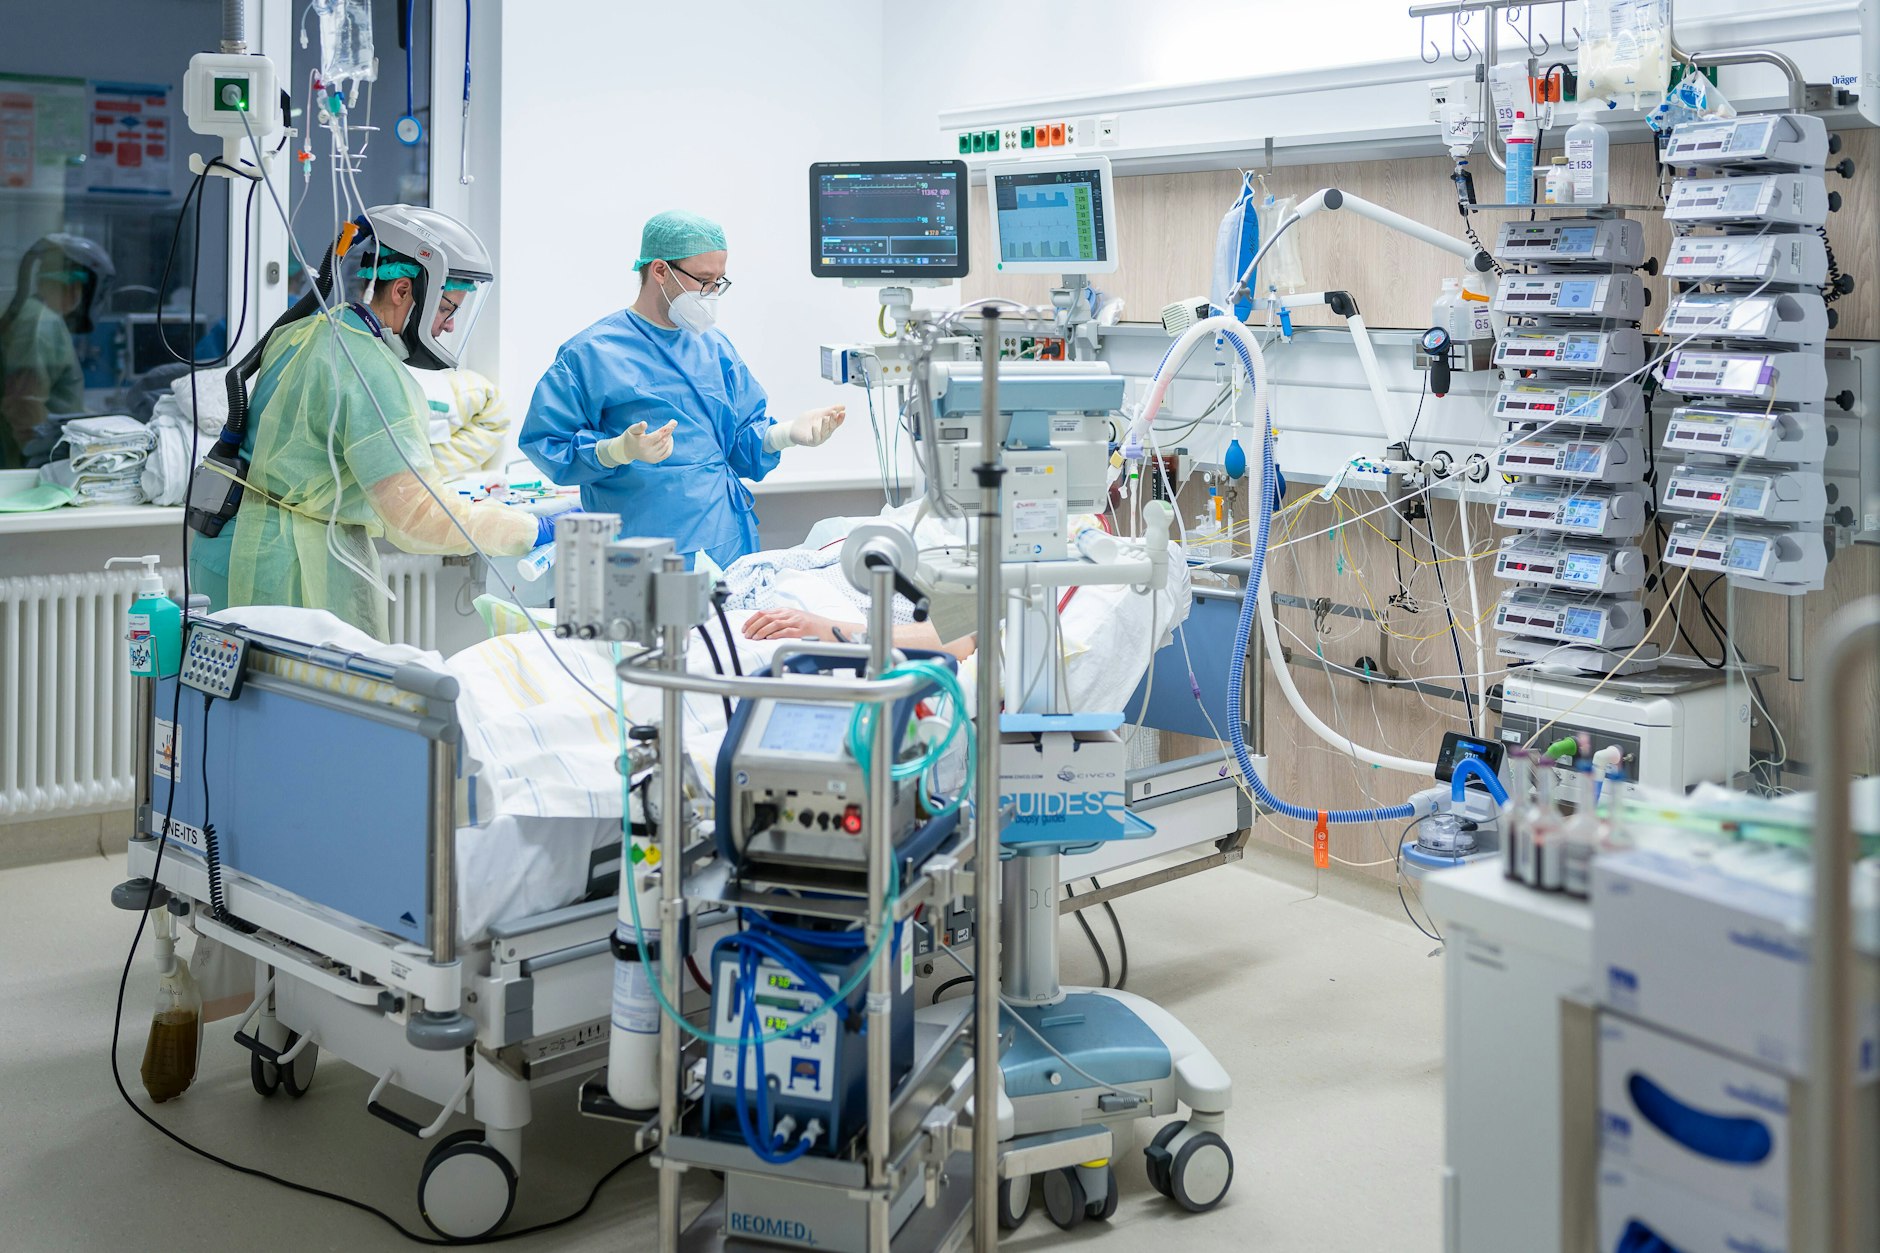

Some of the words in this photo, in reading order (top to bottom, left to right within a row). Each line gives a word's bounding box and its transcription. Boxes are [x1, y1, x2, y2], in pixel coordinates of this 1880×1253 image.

[1832, 75, 1857, 85] Dräger
[1568, 161, 1575, 169] E
[1576, 160, 1592, 170] 153
[1077, 771, 1116, 779] CIVCO
[1041, 814, 1066, 826] guides
[731, 1212, 806, 1240] REOMED
